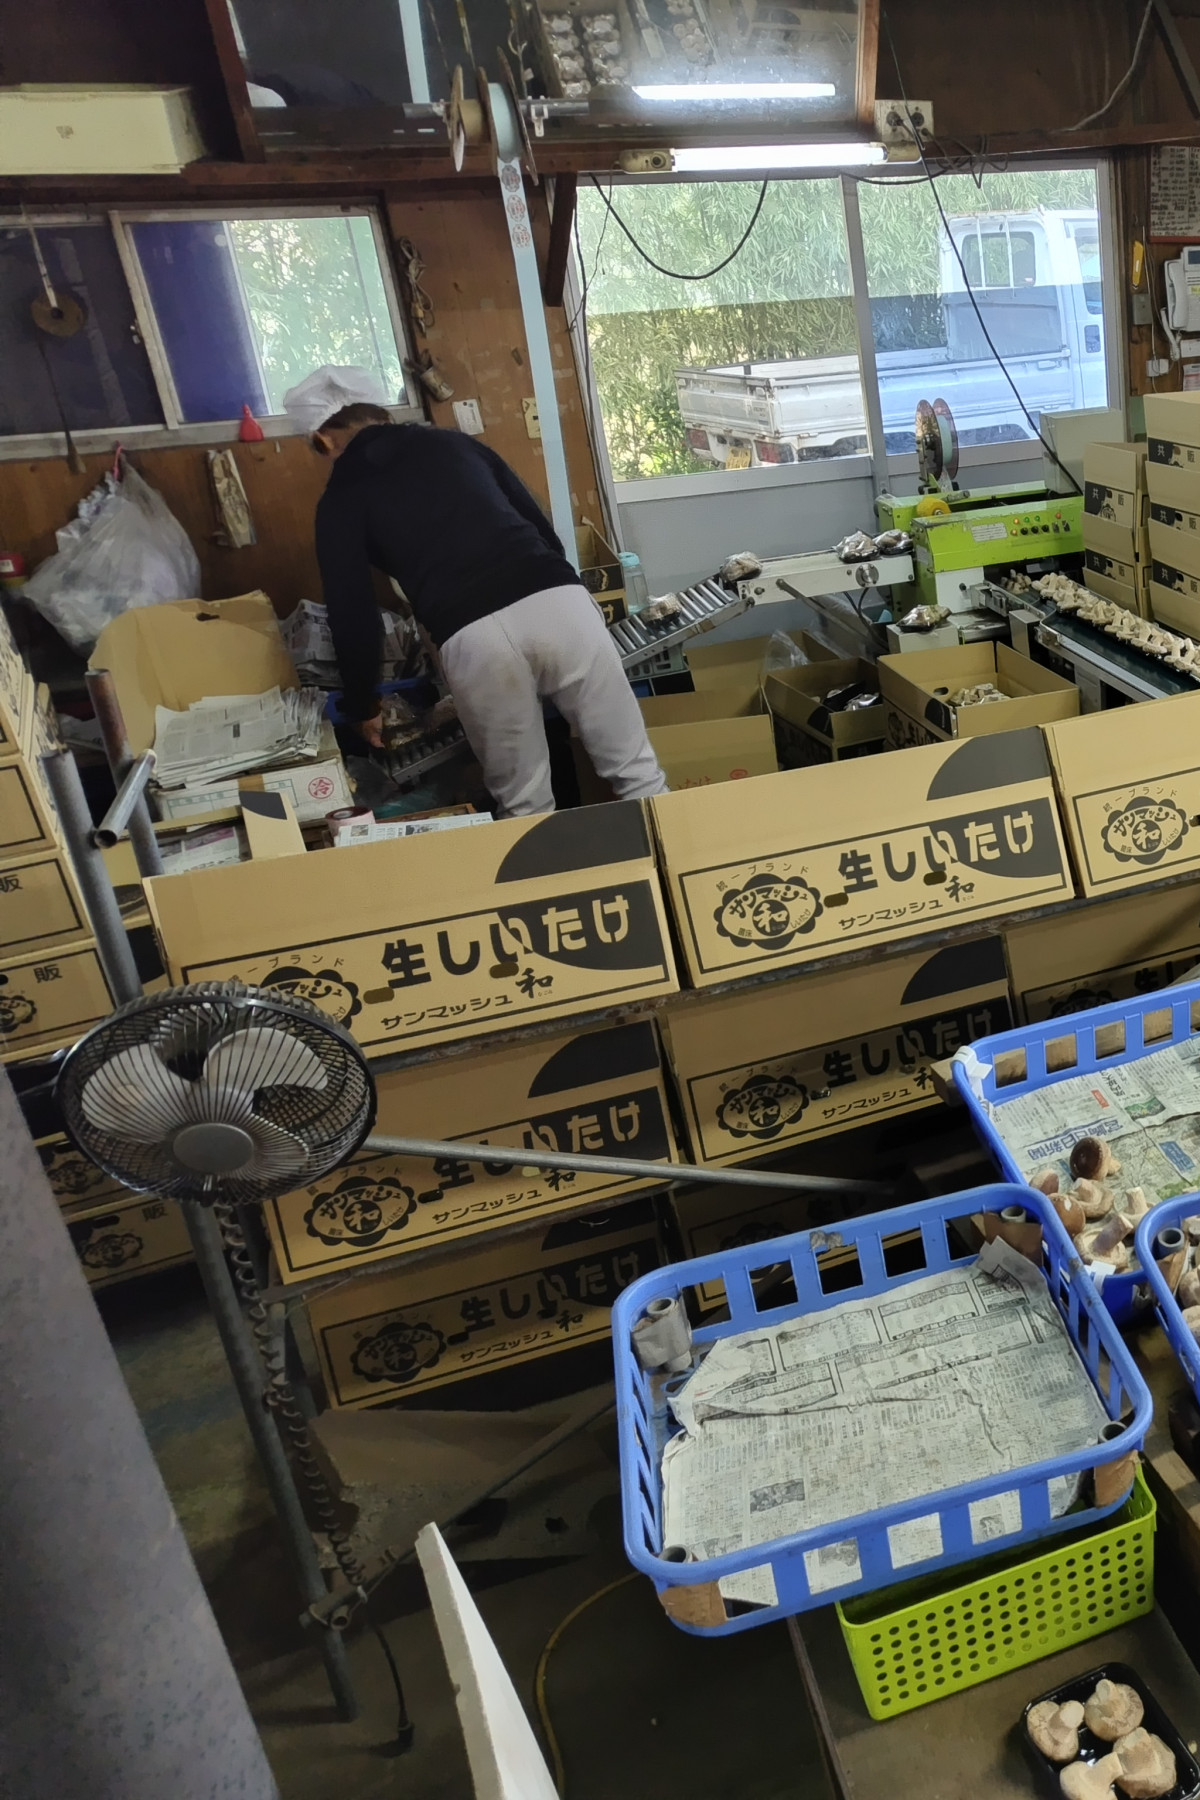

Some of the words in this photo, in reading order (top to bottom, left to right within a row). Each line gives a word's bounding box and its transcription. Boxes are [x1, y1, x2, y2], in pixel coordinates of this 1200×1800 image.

[312, 778, 331, 797] 冷
[838, 811, 1034, 894] 生しいたけ
[1132, 821, 1161, 850] 和
[752, 902, 789, 933] 和
[838, 899, 943, 930] サンマッシュ
[944, 875, 975, 903] 和
[381, 895, 630, 990] 生しいたけ
[33, 964, 63, 984] 販
[380, 994, 513, 1030] サンマッシュ
[515, 967, 554, 999] 和
[823, 1008, 992, 1088] 生しいたけ
[822, 1088, 912, 1120] サンマッシュ
[432, 1189, 542, 1225] サンマッシュ
[460, 1251, 639, 1332] 生しいたけ
[460, 1331, 553, 1363] サンマッシュ
